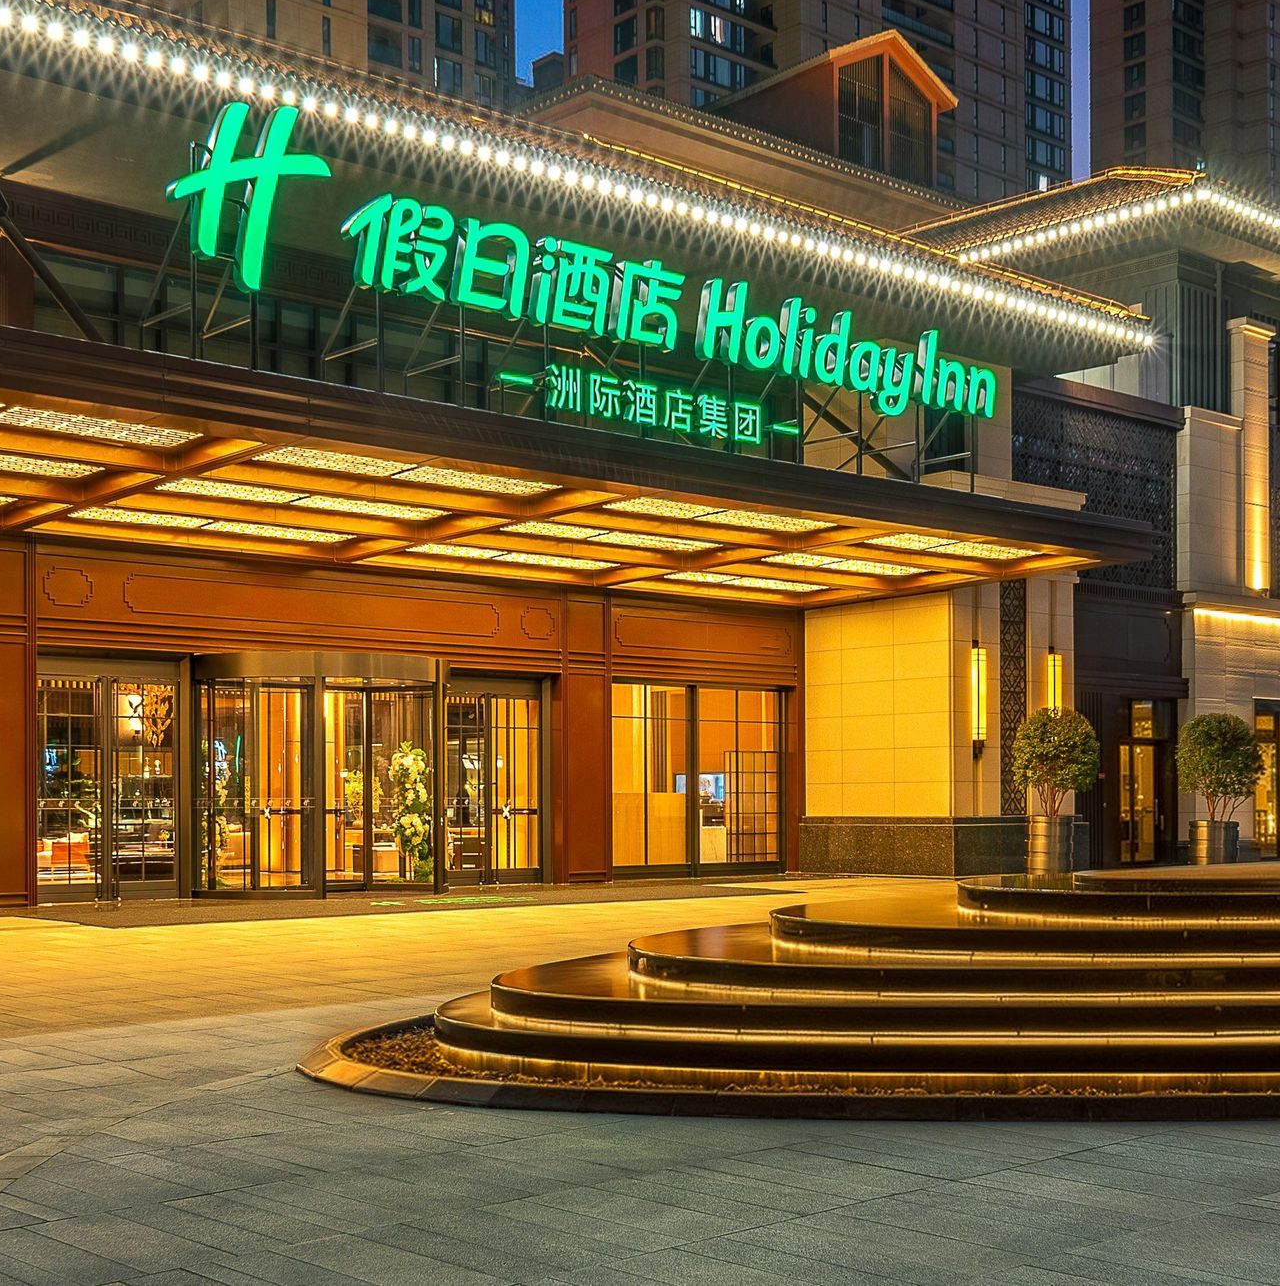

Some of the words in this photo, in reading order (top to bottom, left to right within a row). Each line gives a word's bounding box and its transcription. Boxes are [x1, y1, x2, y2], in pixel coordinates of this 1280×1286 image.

[341, 193, 686, 353] 假日酒店
[545, 364, 762, 445] 洲际酒店集团
